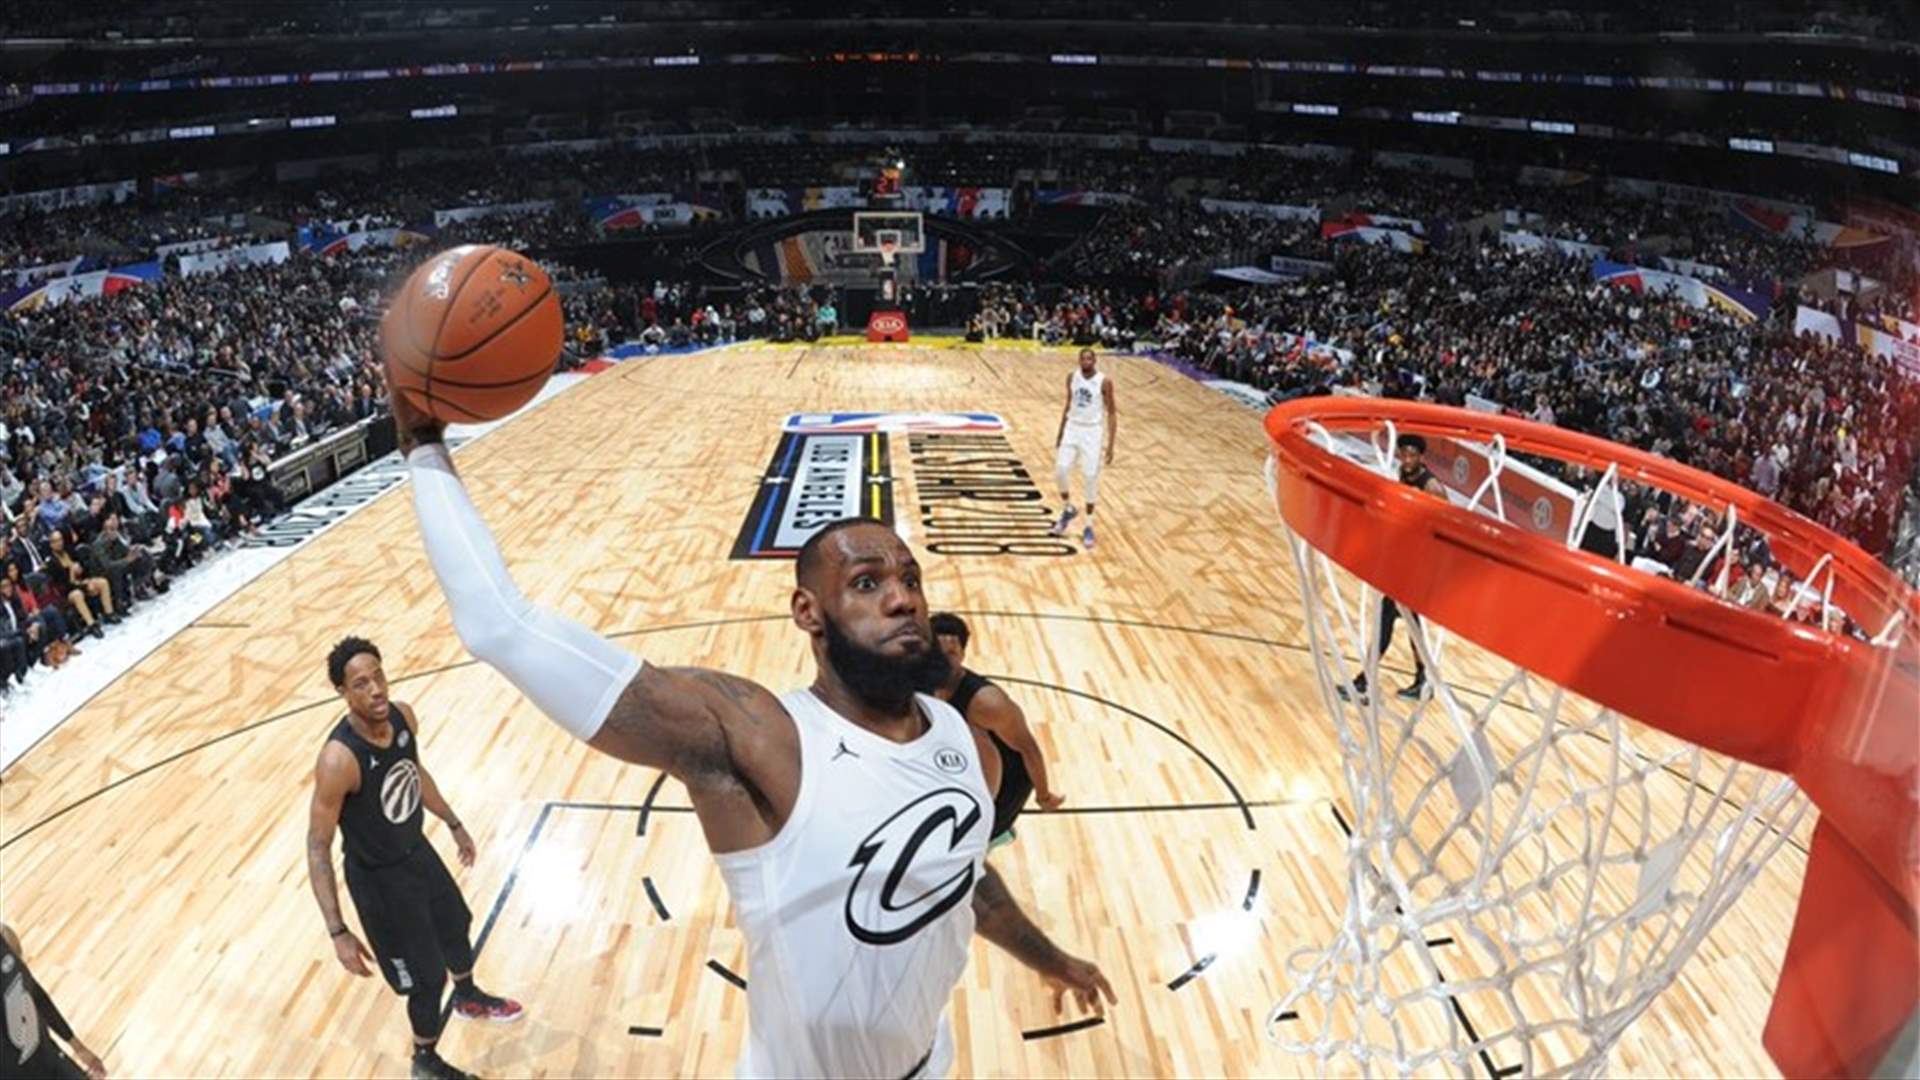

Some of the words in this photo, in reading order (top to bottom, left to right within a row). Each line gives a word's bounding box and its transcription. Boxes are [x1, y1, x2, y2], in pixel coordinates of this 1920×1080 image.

[810, 443, 849, 462] LOS
[792, 466, 847, 529] ANGELES
[940, 753, 963, 768] KIA
